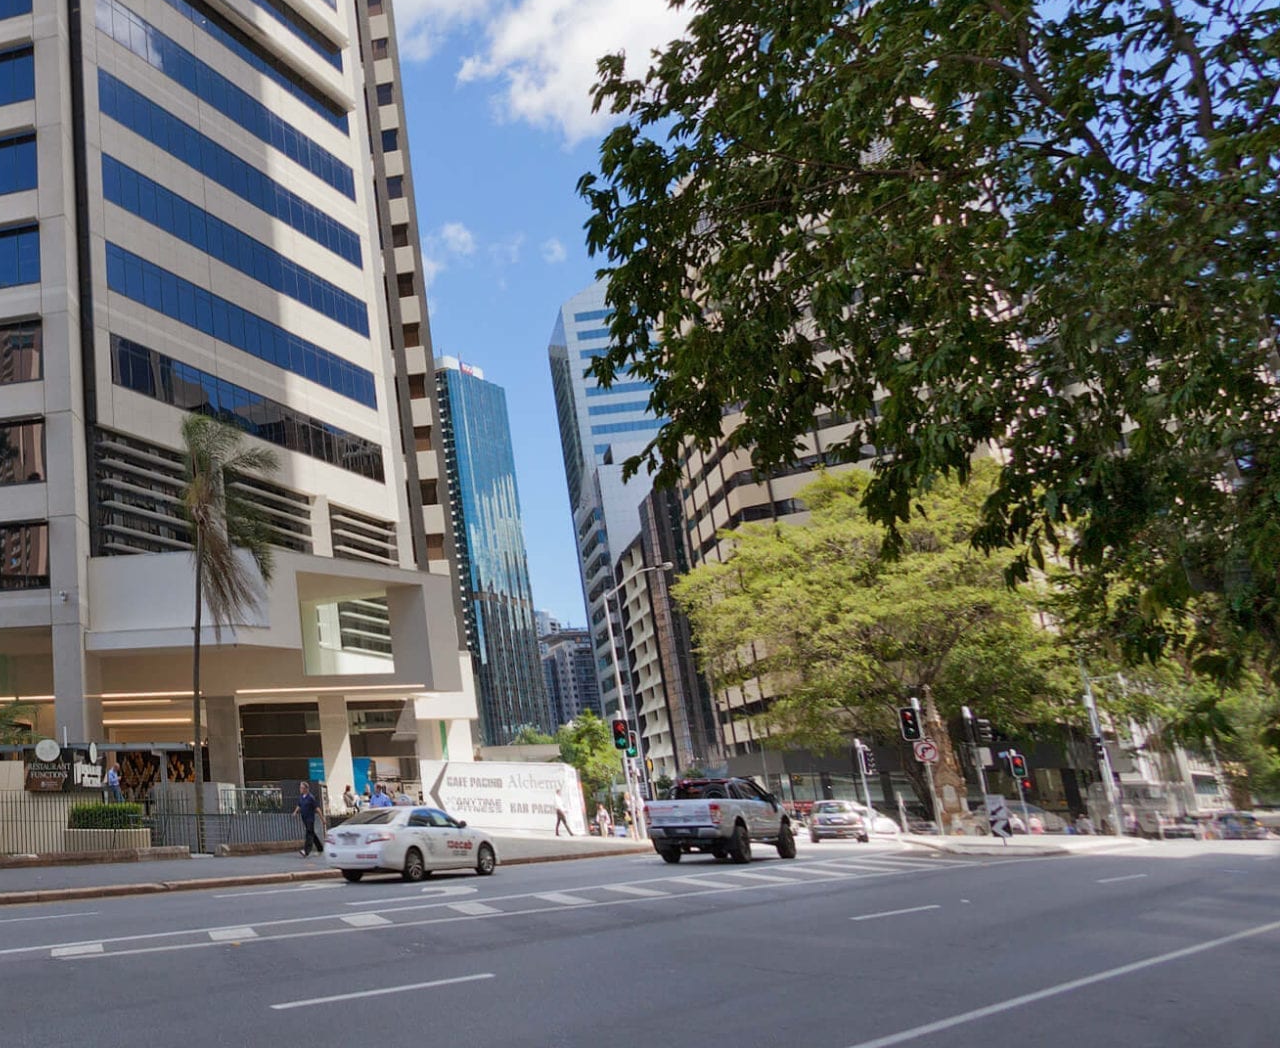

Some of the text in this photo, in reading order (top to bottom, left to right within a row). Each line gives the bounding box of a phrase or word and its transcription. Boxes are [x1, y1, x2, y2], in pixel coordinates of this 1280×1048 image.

[28, 762, 71, 771] RESTAURANT
[30, 771, 68, 779] FUNCTIONS
[447, 776, 468, 787] CAFE
[508, 773, 565, 791] Alchemy
[456, 797, 502, 806] ANYTIME
[457, 805, 502, 814] FITNESS
